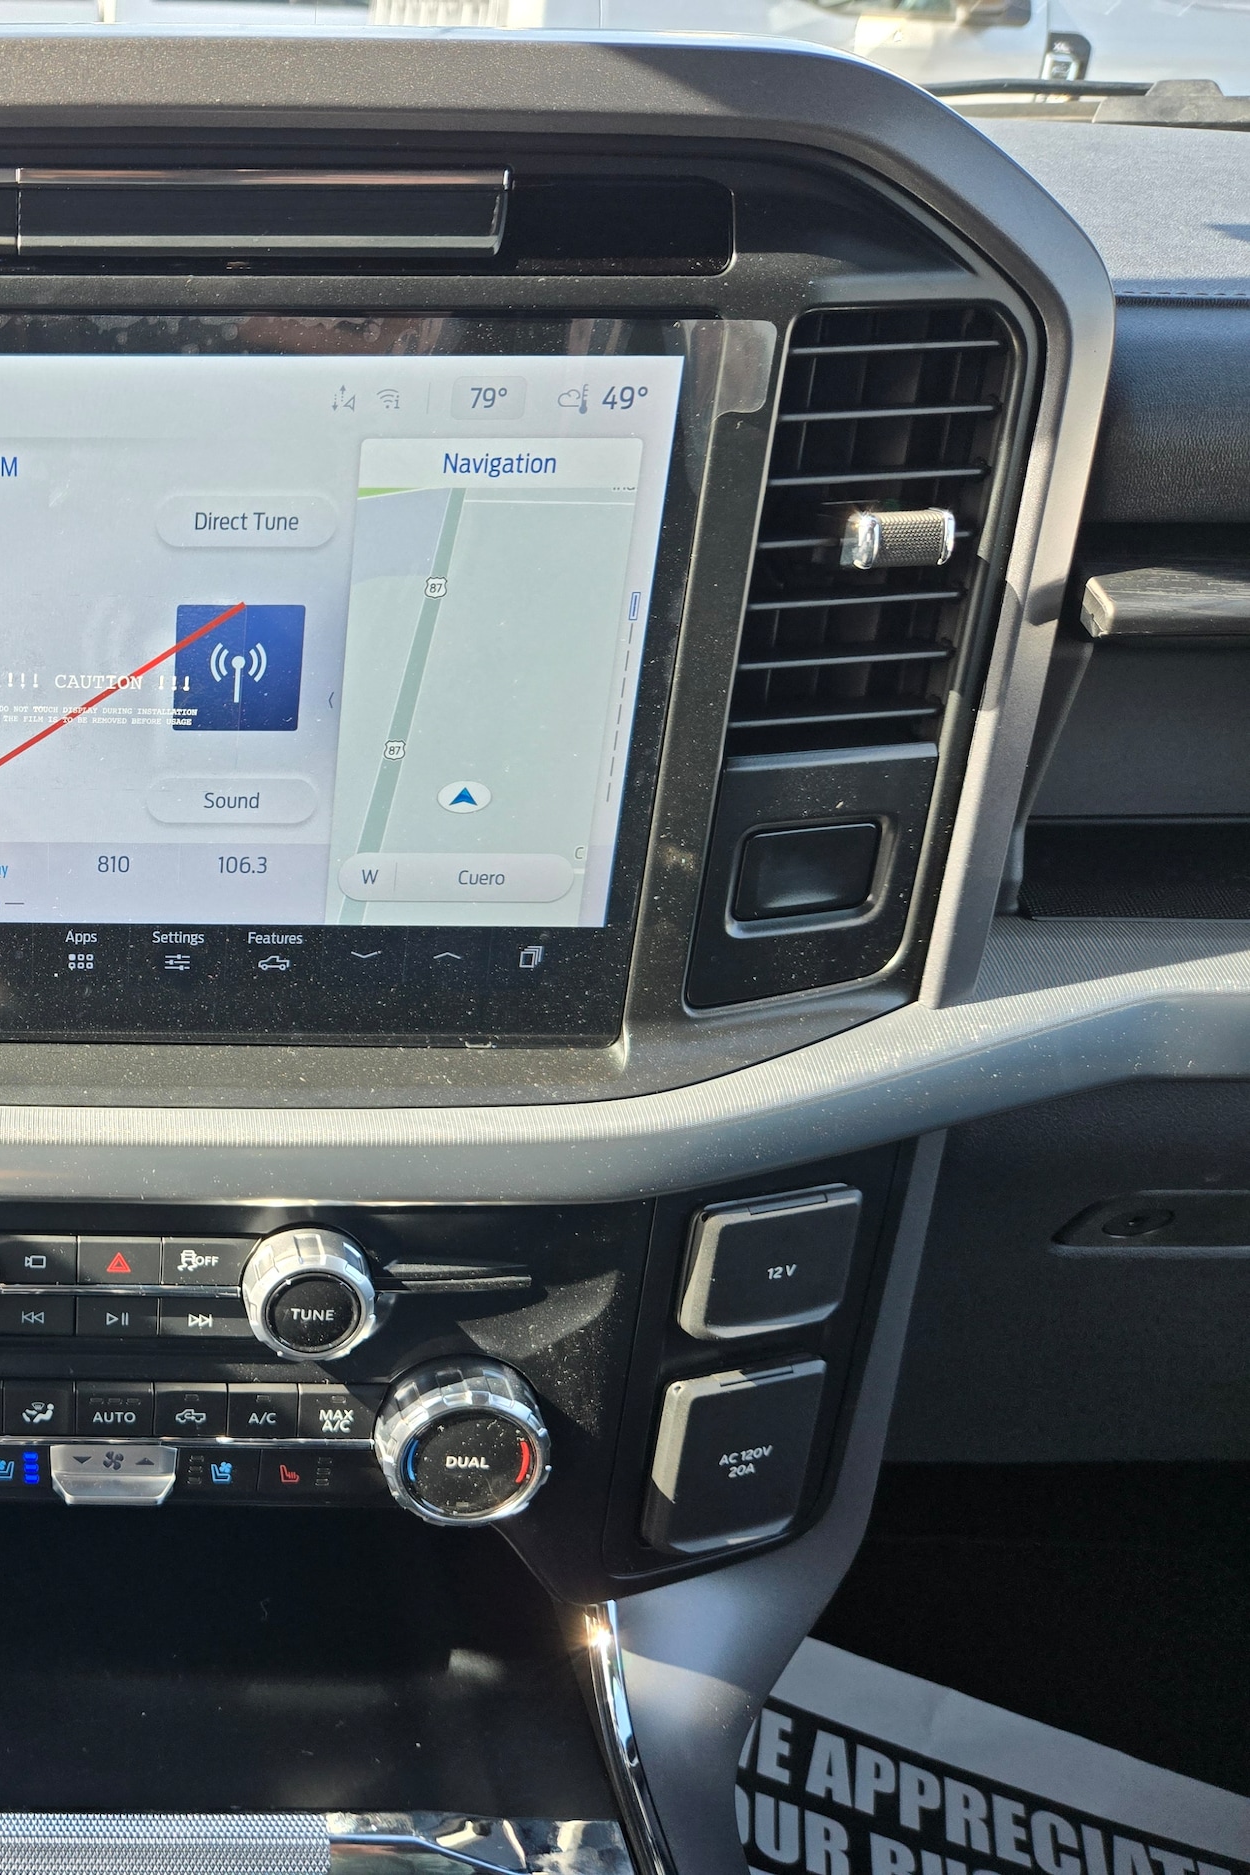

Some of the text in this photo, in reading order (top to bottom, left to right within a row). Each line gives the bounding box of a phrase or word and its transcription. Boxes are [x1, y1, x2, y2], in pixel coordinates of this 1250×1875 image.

[469, 387, 508, 409] 79°
[601, 386, 649, 410] 49°
[443, 453, 557, 478] Navigation
[194, 512, 299, 532] Direct Tune
[429, 581, 443, 594] 87
[54, 674, 143, 690] CAUTION
[32, 706, 59, 714] TOUCH
[62, 707, 98, 715] DISPLAY
[102, 707, 133, 715] DURING
[137, 708, 198, 716] INSTALLATION
[92, 717, 127, 725] REMOVED
[166, 718, 192, 726] USAGE
[388, 745, 402, 757] 87
[203, 791, 260, 810] Sound
[97, 855, 130, 874] 810
[218, 855, 268, 875] 106.3
[362, 869, 506, 886] W Cuero
[65, 930, 97, 945] Apps
[152, 930, 205, 947] Settings
[247, 931, 303, 945] Features
[197, 1256, 219, 1266] OFF
[290, 1308, 335, 1321] TUNE
[93, 1412, 136, 1423] AUTO
[249, 1412, 277, 1424] A/C
[319, 1409, 352, 1421] MAX
[322, 1421, 350, 1432] A/C
[445, 1456, 490, 1469] DUAL
[719, 1445, 773, 1467] AC 120V
[728, 1463, 756, 1479] 20A
[738, 1708, 1232, 1875] E APPRECIA
